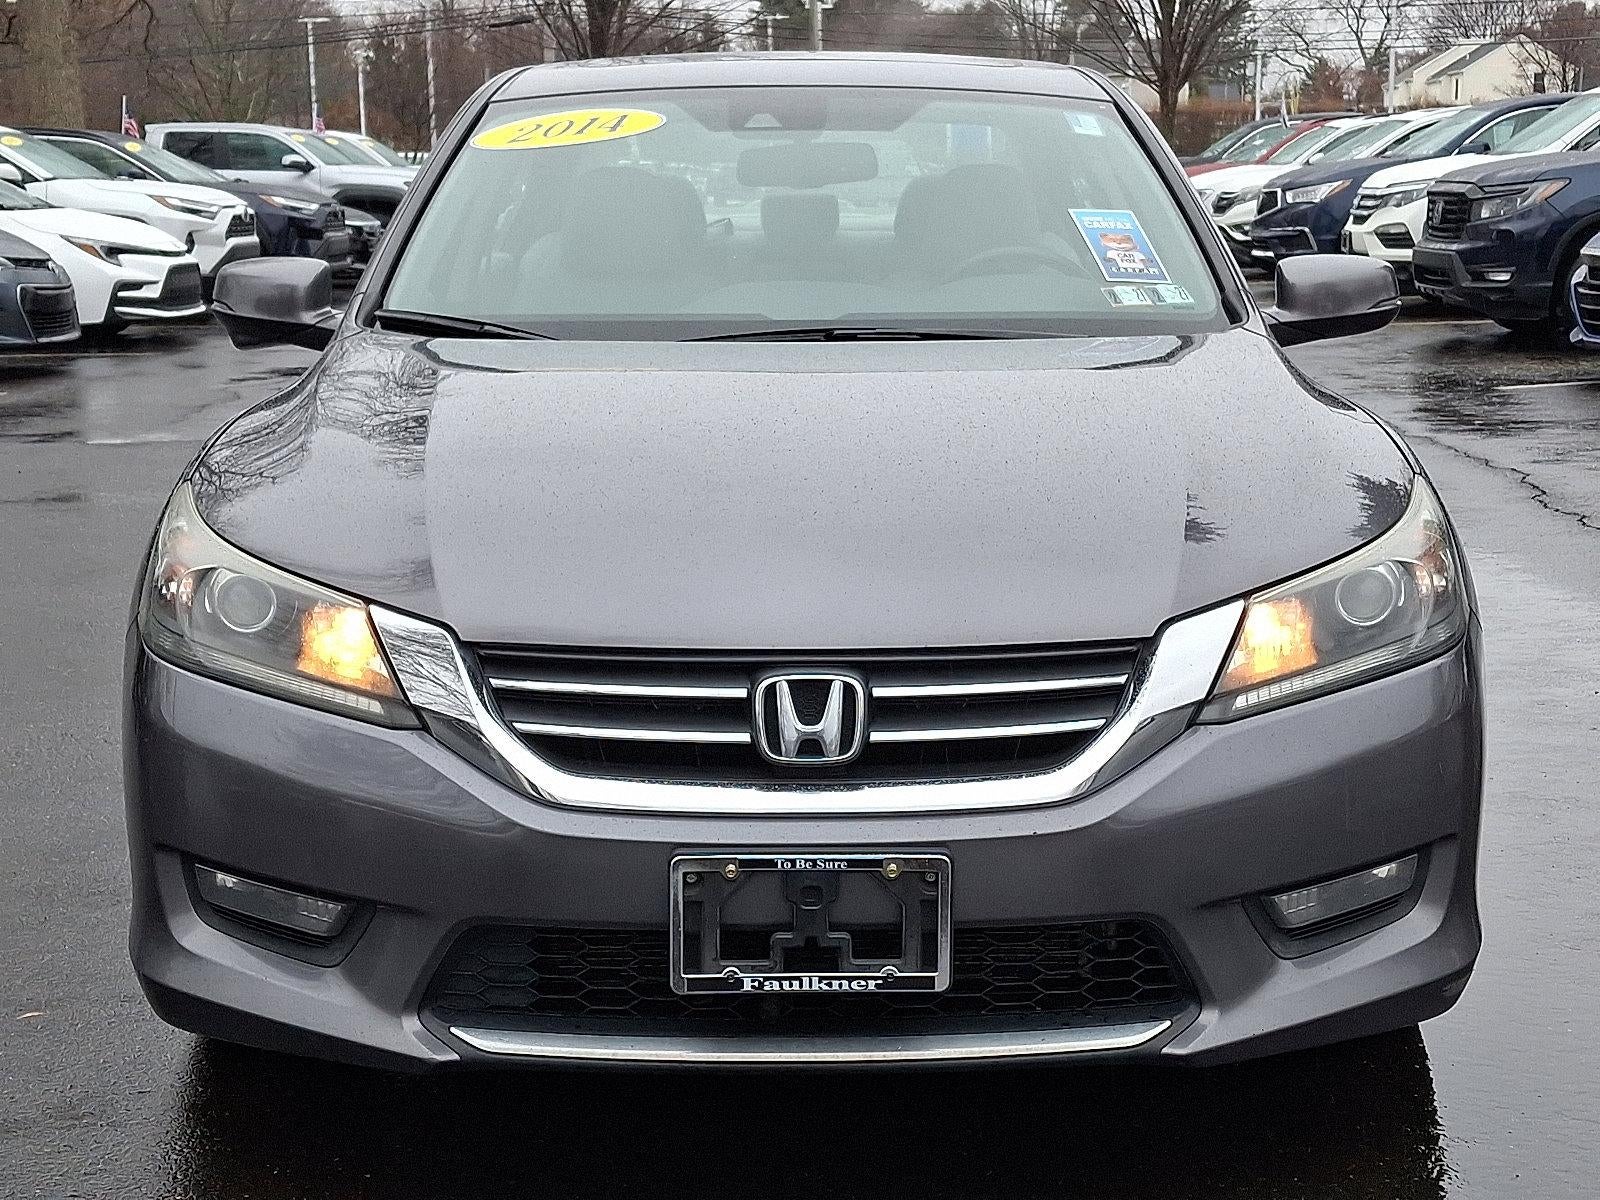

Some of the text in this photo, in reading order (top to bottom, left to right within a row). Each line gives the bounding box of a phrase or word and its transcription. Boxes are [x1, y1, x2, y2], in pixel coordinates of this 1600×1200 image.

[508, 114, 628, 143] 2014
[774, 858, 848, 869] To Be Sure
[741, 977, 883, 991] Faulkner
